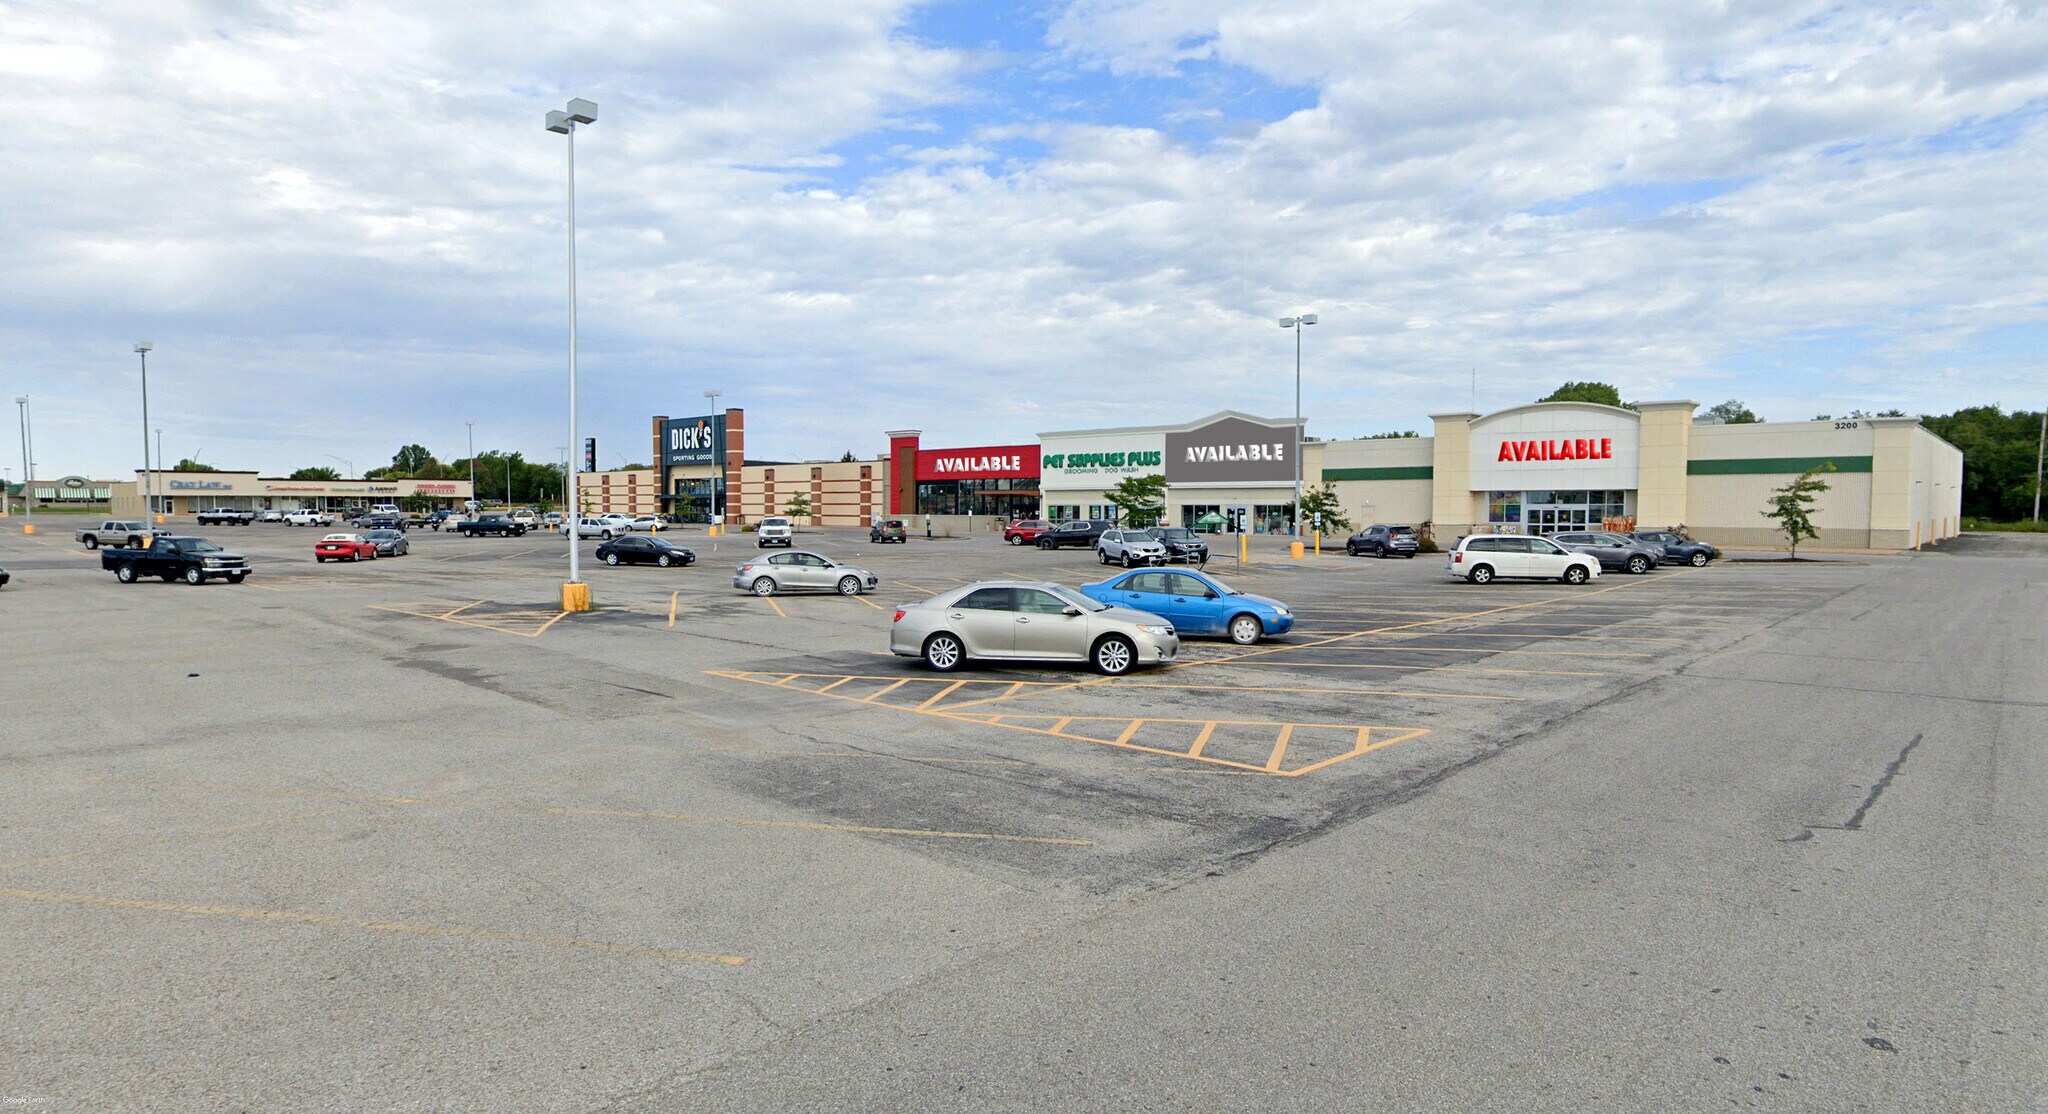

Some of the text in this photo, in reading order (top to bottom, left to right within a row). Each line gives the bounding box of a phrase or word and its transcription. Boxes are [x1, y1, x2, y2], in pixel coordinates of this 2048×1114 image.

[672, 424, 711, 450] DICK'S
[1043, 451, 1161, 469] PET SUPPLIES PLUS
[1184, 443, 1284, 463] AVAILABLE
[1498, 438, 1611, 462] AVAILABLE
[934, 456, 1020, 472] AVAILABLE
